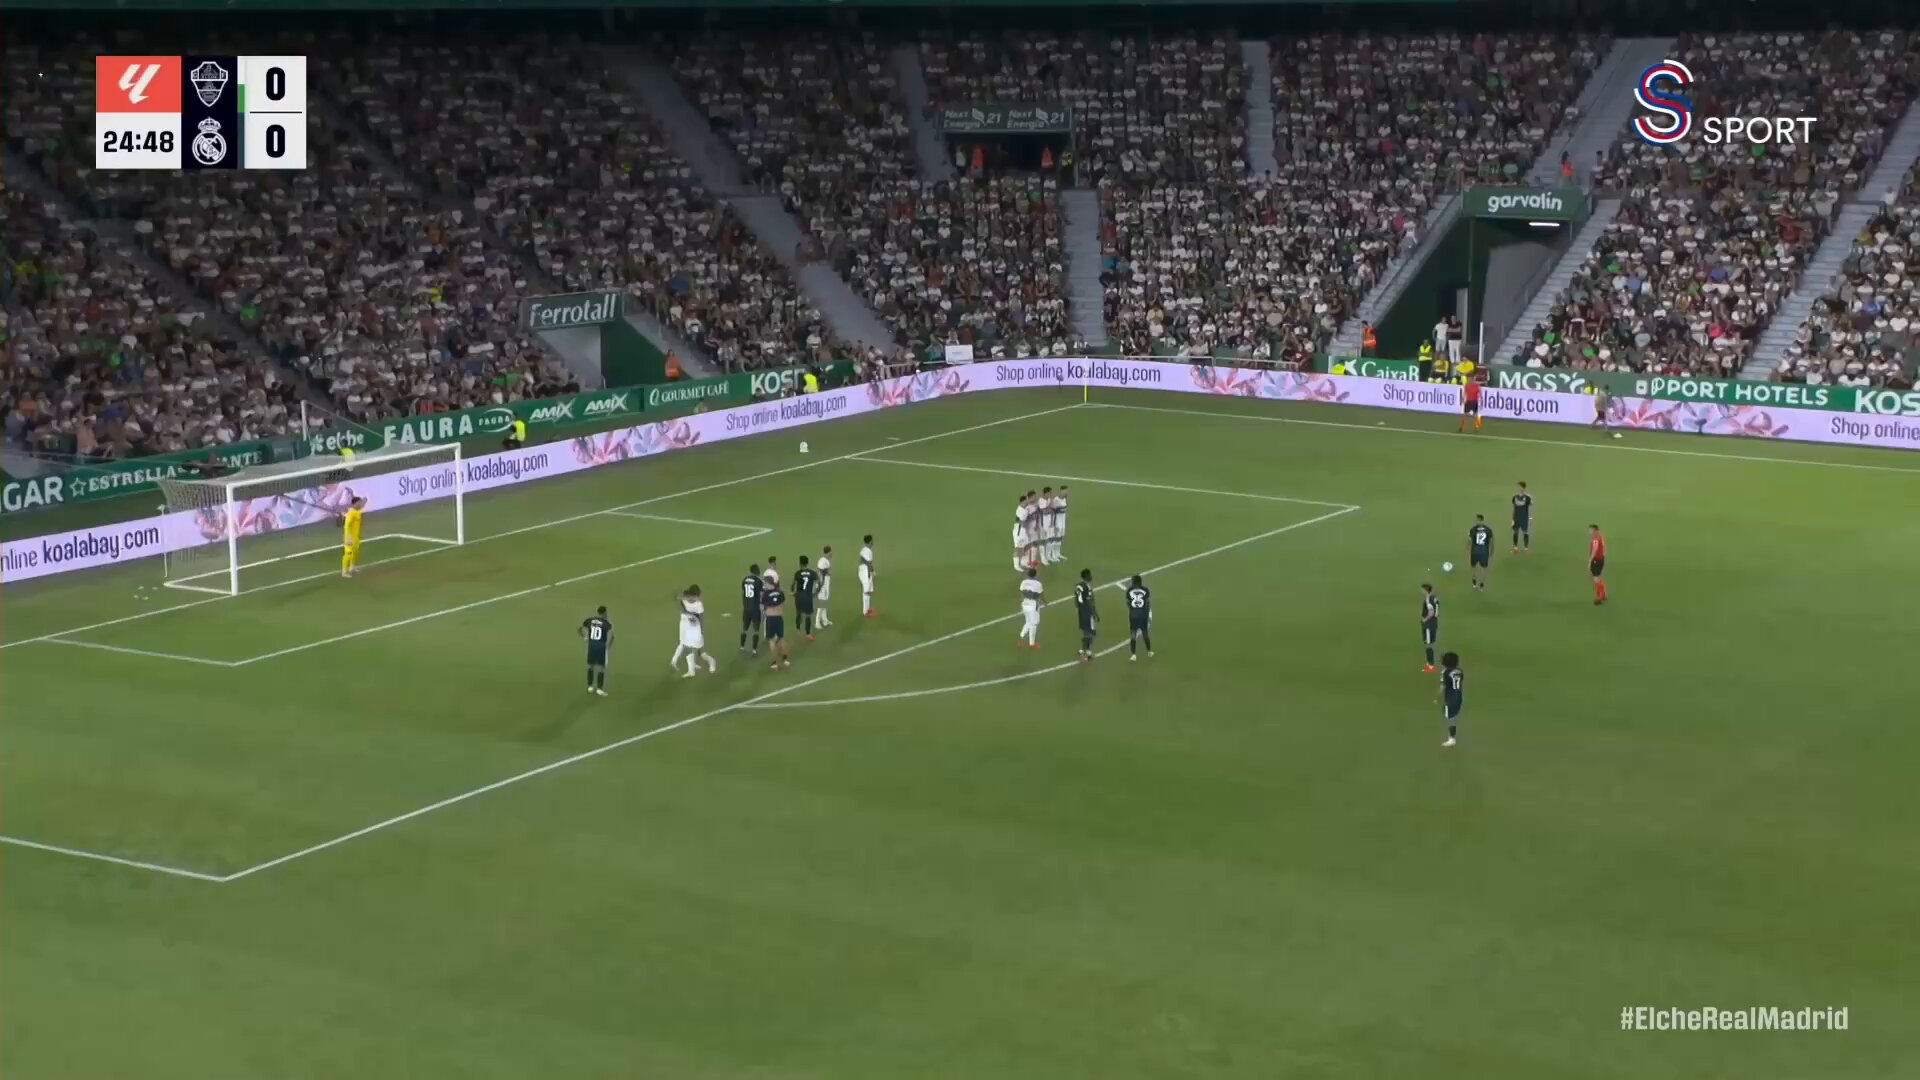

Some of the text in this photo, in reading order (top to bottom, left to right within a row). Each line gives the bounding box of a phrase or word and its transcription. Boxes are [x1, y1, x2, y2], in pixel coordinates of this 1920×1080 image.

[529, 293, 616, 328] Ferrotall
[996, 364, 1024, 384] Shop
[1028, 363, 1063, 380] online
[1500, 371, 1557, 391] MGS
[583, 392, 629, 415] AMIX
[661, 386, 706, 402] GOURMET
[1383, 384, 1559, 416] Shop online labay.com
[1667, 380, 1828, 406] PORT HOTELS
[529, 399, 575, 421] AMIX
[726, 394, 847, 431] Shop online koalabay.com
[384, 414, 474, 447] FAURA
[1831, 416, 1920, 441] Shop online
[88, 466, 177, 491] ESTRELLA
[399, 477, 427, 496] Shop
[467, 454, 548, 482] koalabay.com
[0, 476, 64, 513] GAR
[43, 525, 159, 560] koalabay.com
[1476, 532, 1487, 545] 12
[802, 577, 809, 590] 7
[590, 626, 601, 640] 10
